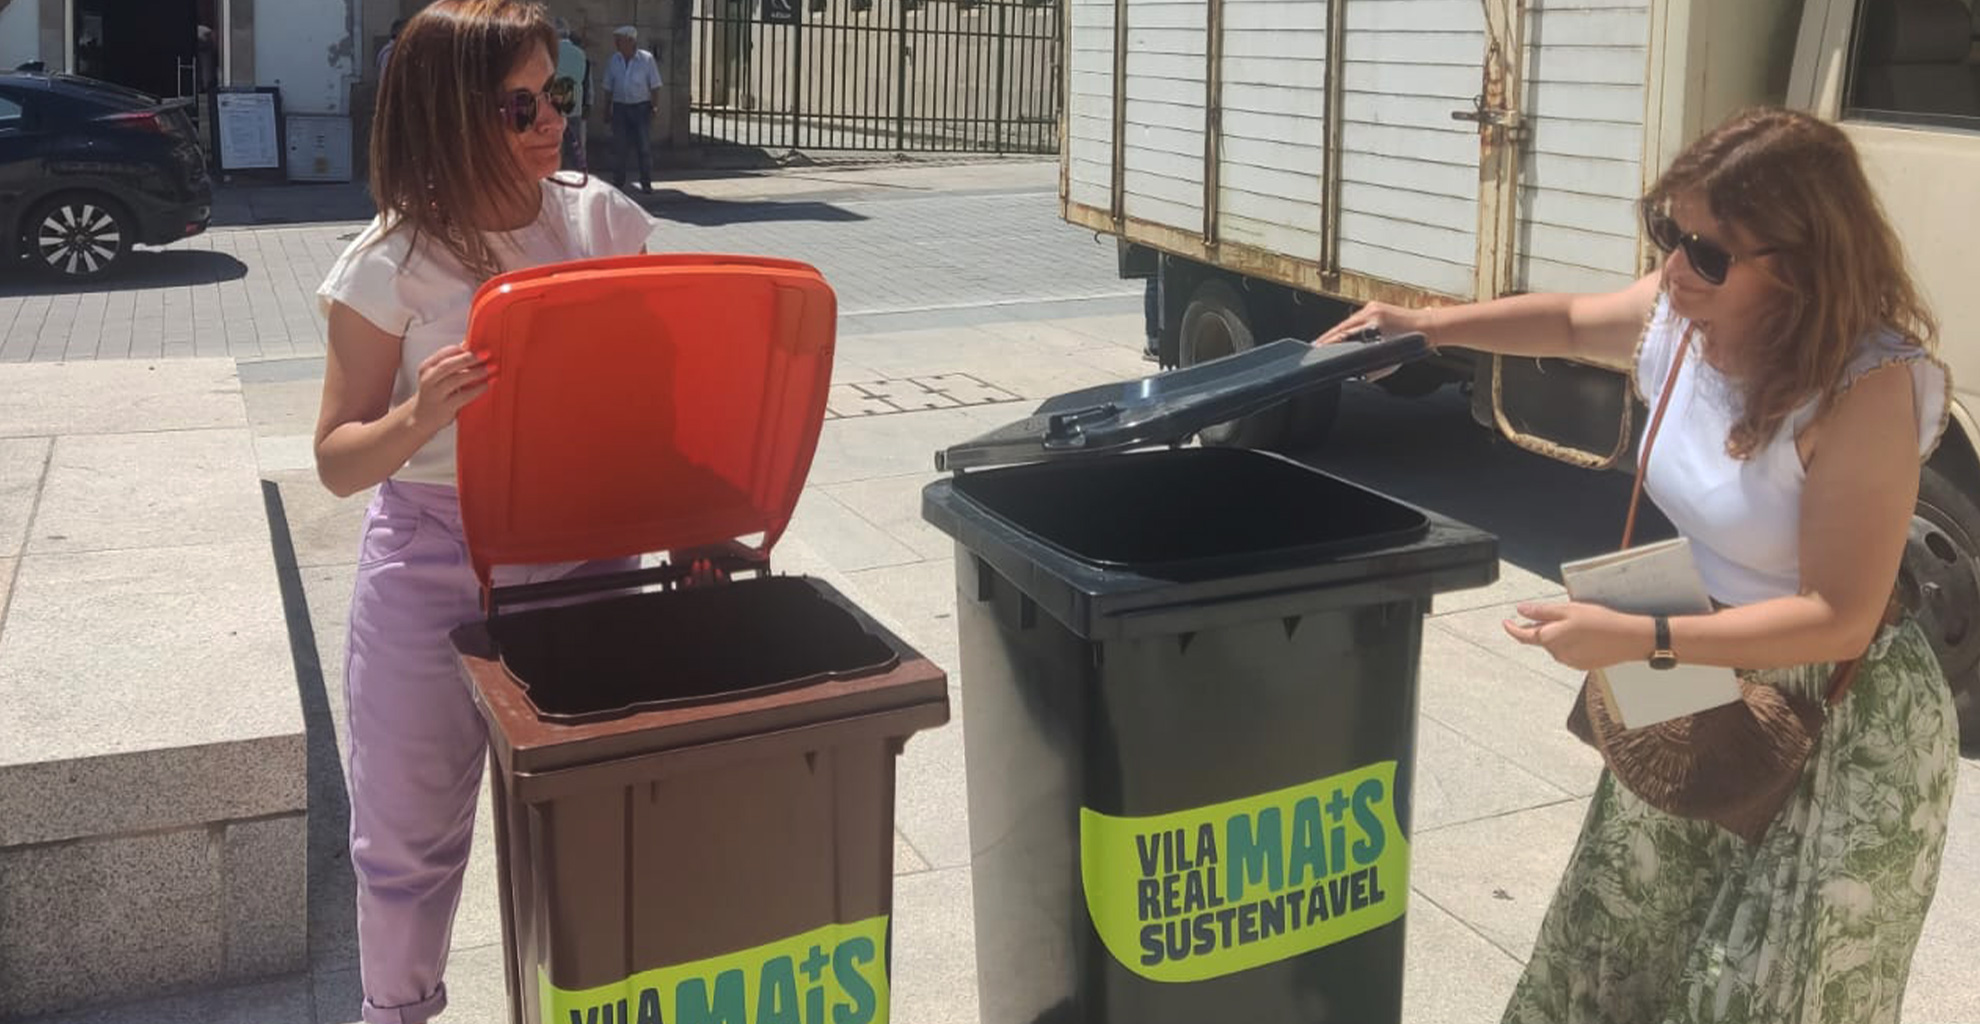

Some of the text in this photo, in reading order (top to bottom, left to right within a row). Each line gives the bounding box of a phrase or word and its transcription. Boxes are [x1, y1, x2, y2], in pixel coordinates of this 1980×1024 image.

[1135, 823, 1218, 878] VILA
[1137, 866, 1224, 921] REAL
[1139, 864, 1386, 967] SUSTENTÁVEL
